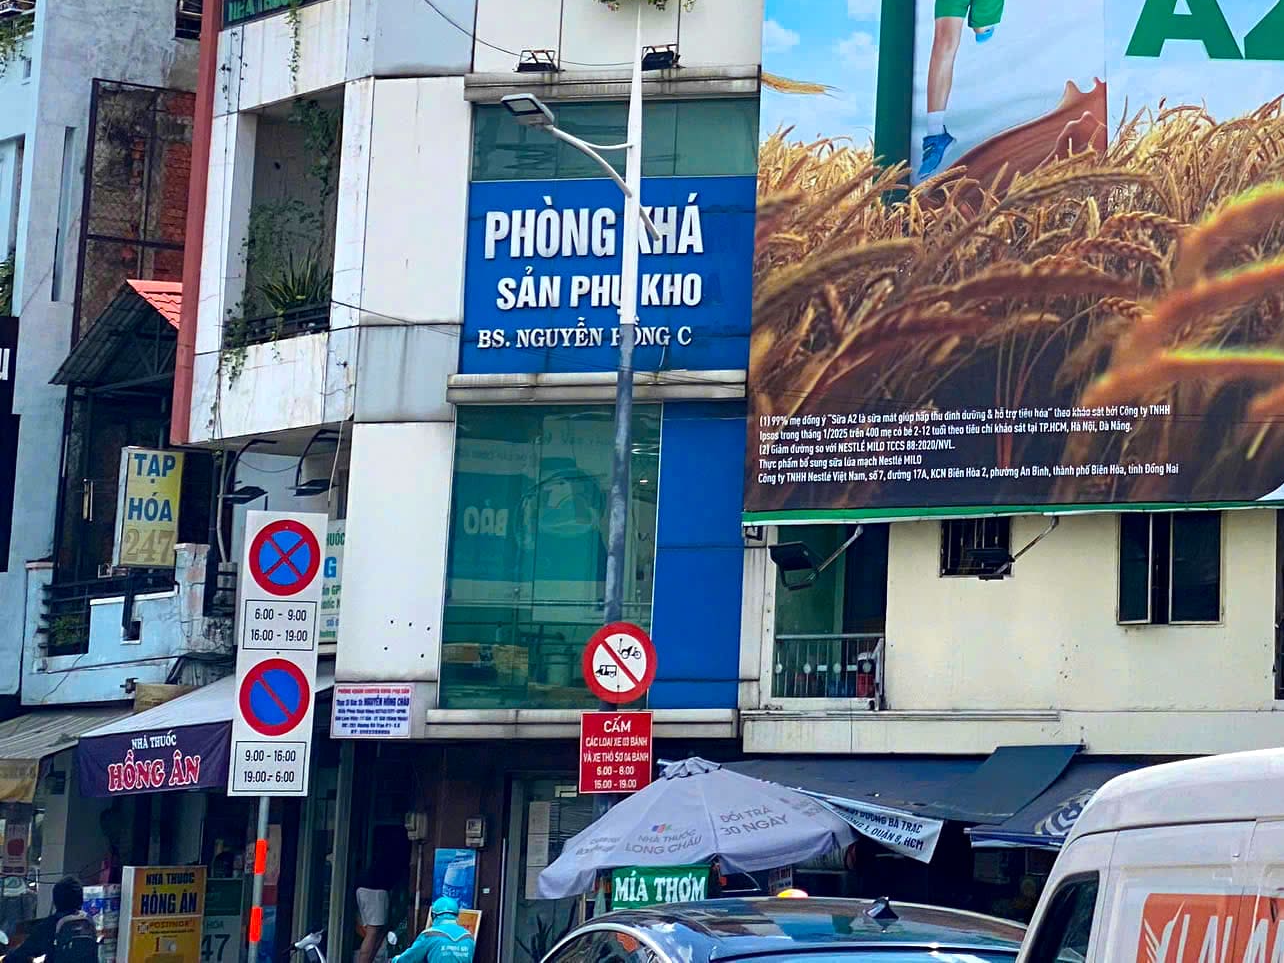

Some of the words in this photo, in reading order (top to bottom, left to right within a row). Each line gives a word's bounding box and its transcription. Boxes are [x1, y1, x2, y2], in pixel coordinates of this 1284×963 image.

[484, 196, 616, 259] PHÒNG
[496, 265, 561, 310] SẢN
[641, 273, 702, 306] KHO
[477, 328, 511, 349] BS.
[516, 317, 603, 347] NGUYỄN
[759, 444, 770, 456] (2)
[790, 442, 814, 456] đường
[815, 445, 824, 453] so
[838, 439, 865, 452] NESTLÉ
[866, 440, 885, 452] MILO
[886, 440, 905, 451] TCCS
[134, 453, 176, 484] TẠP
[759, 458, 777, 469] Thực
[809, 459, 827, 469] sung
[857, 455, 877, 468] mạch
[903, 455, 922, 465] MILO
[758, 473, 776, 485] Công
[777, 473, 785, 484] ty
[786, 472, 805, 482] TNHH
[832, 471, 848, 483] Việt
[128, 492, 173, 522] HÓA
[124, 528, 175, 563] 247
[255, 608, 274, 621] 6:00
[287, 609, 307, 621] 9:00
[251, 629, 274, 641] 16:00
[285, 630, 308, 642] 19:00
[604, 716, 631, 732] CẤM
[131, 737, 149, 750] NHÀ
[149, 730, 177, 748] THUỐC
[585, 735, 598, 746] CÁC
[614, 737, 621, 746] XE
[630, 735, 648, 746] BÁNH
[244, 750, 265, 762] 9:00
[274, 750, 297, 762] 16:00
[583, 750, 591, 763] VÀ
[593, 753, 600, 762] XE
[632, 750, 649, 762] BÁNH
[107, 749, 166, 791] HỒNG
[169, 749, 201, 786] ÂN
[243, 771, 266, 783] 19:00
[275, 771, 295, 783] 6:00
[720, 826, 741, 835] 30
[625, 843, 665, 854] LONG
[667, 836, 702, 853] CHÂU
[904, 836, 924, 851] HCM
[614, 870, 649, 902] MÍA
[654, 873, 706, 902] THƠM
